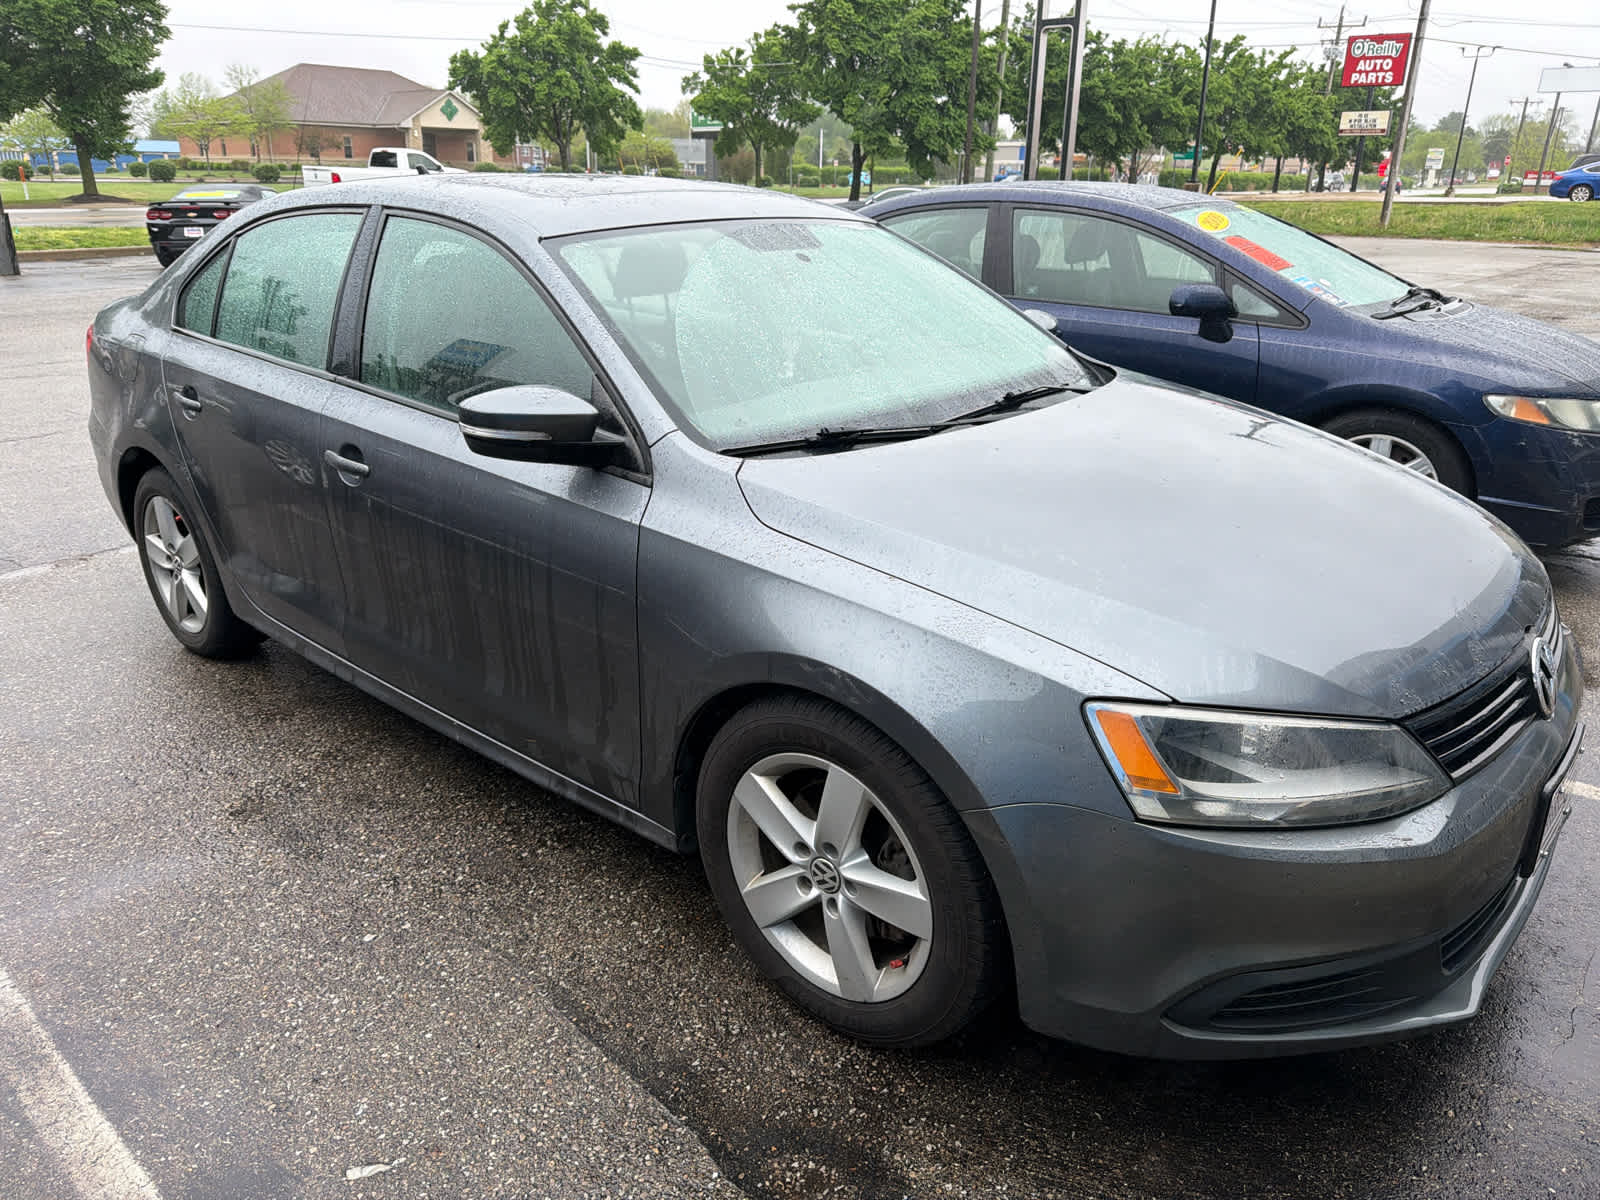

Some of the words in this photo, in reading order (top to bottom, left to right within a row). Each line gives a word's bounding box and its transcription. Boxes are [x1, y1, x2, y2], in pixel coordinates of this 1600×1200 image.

[1352, 39, 1403, 57] O'Reilly
[1356, 59, 1393, 71] AUTO
[1351, 72, 1393, 84] PARTS
